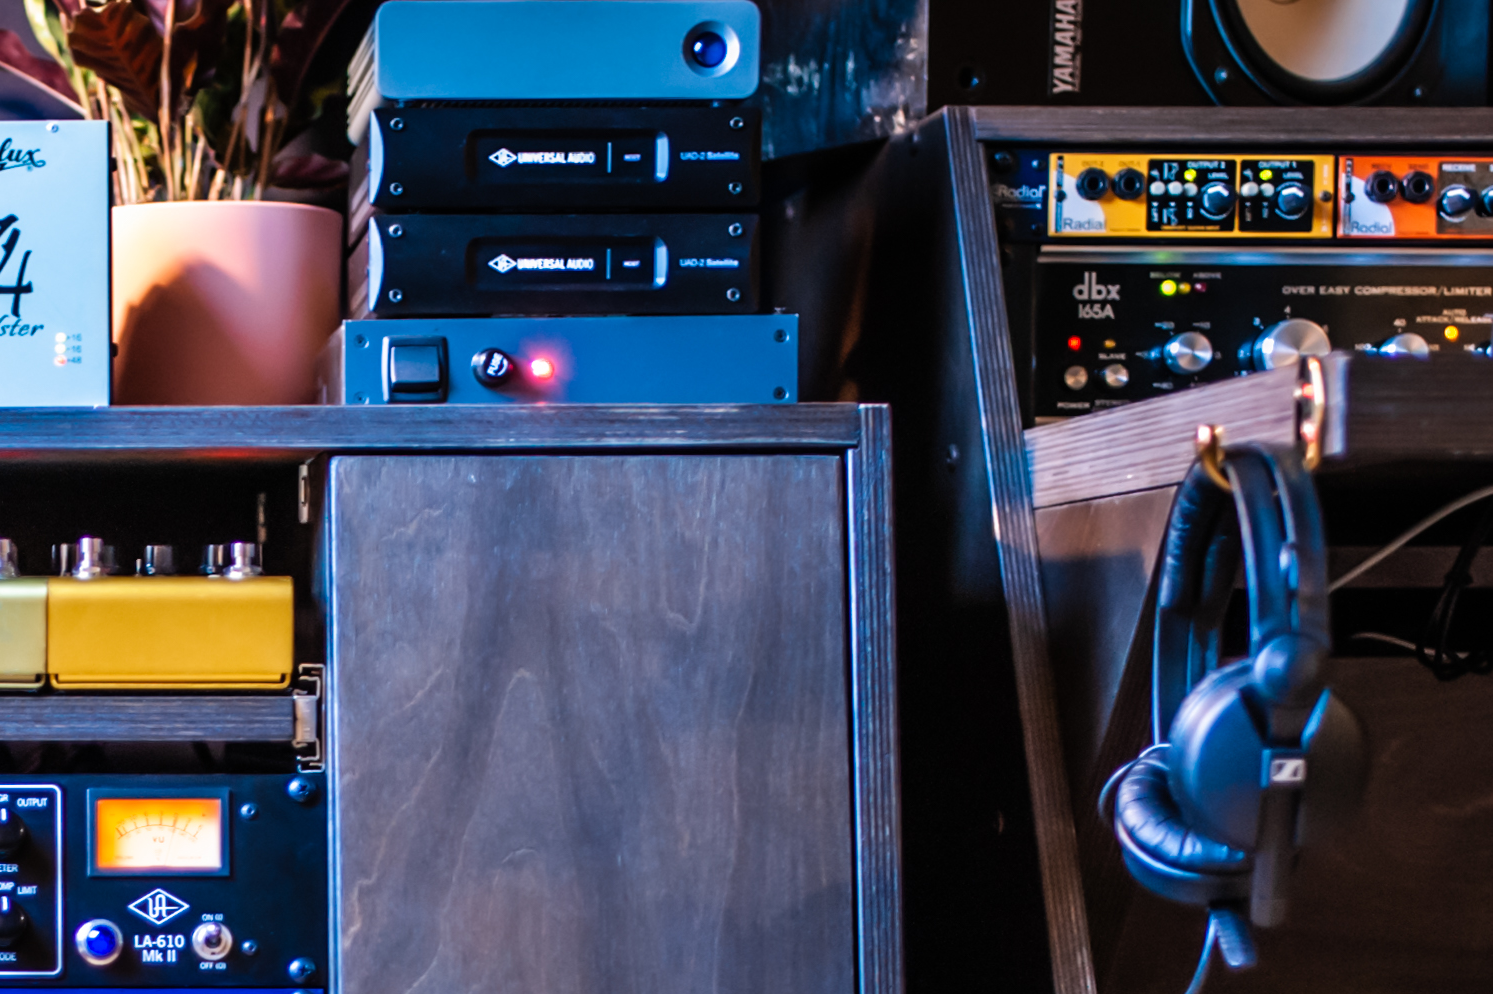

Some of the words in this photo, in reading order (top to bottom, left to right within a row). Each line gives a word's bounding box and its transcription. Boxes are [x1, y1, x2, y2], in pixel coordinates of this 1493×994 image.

[1052, 0, 1081, 94] YAMAHA
[517, 152, 566, 164] UNIVERSAL
[567, 152, 596, 164] AUDIO
[680, 152, 705, 160] UAD-2
[707, 152, 739, 160] Satellite
[1187, 161, 1217, 169] OUTPUT
[1063, 217, 1106, 230] Radial
[1351, 221, 1392, 233] Radial
[516, 258, 565, 270] UNIVERSAL
[566, 258, 595, 270] AUDIO
[679, 258, 704, 266] UAD-2
[706, 258, 738, 266] Satellite
[1073, 271, 1121, 301] dbx
[1282, 286, 1316, 295] OVER
[1319, 286, 1351, 295] EASY
[1354, 286, 1493, 296] COMPRESSOR/LIMITER
[1078, 303, 1115, 319] 165A
[17, 798, 47, 807] OUTPUT
[18, 886, 38, 895] LIMIT
[134, 934, 185, 949] LA-610
[142, 949, 164, 963] Mk
[166, 949, 177, 963] II
